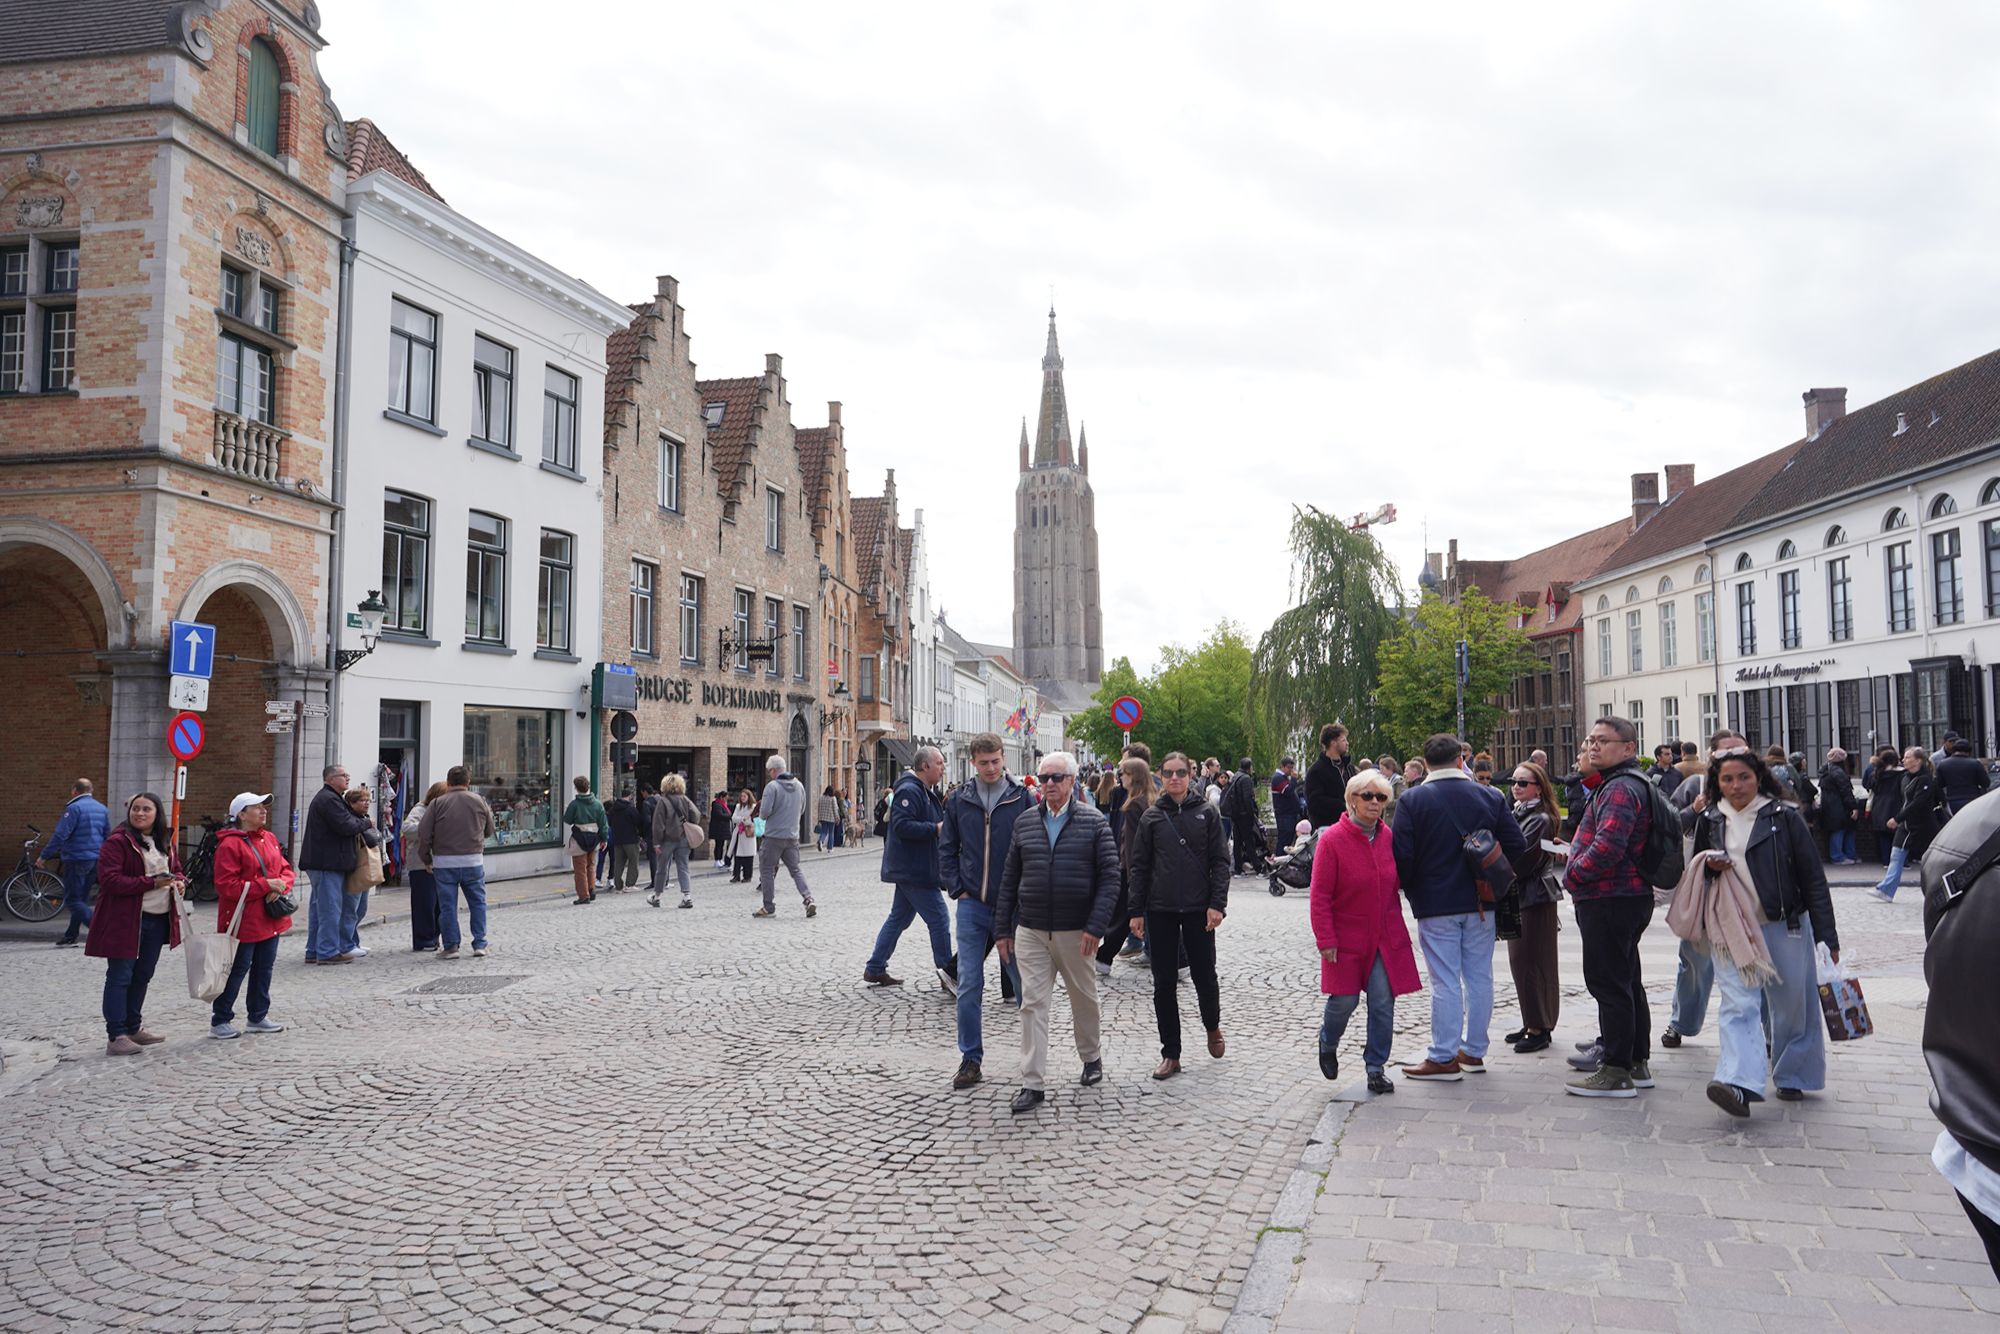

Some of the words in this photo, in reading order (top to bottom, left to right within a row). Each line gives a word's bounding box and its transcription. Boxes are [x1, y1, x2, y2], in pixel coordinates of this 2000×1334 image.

[1735, 665, 1759, 682] Hotel
[636, 674, 693, 705] BRUGSE
[702, 680, 784, 713] BOEKHANDEL
[695, 714, 706, 727] De
[709, 717, 738, 729] Meester
